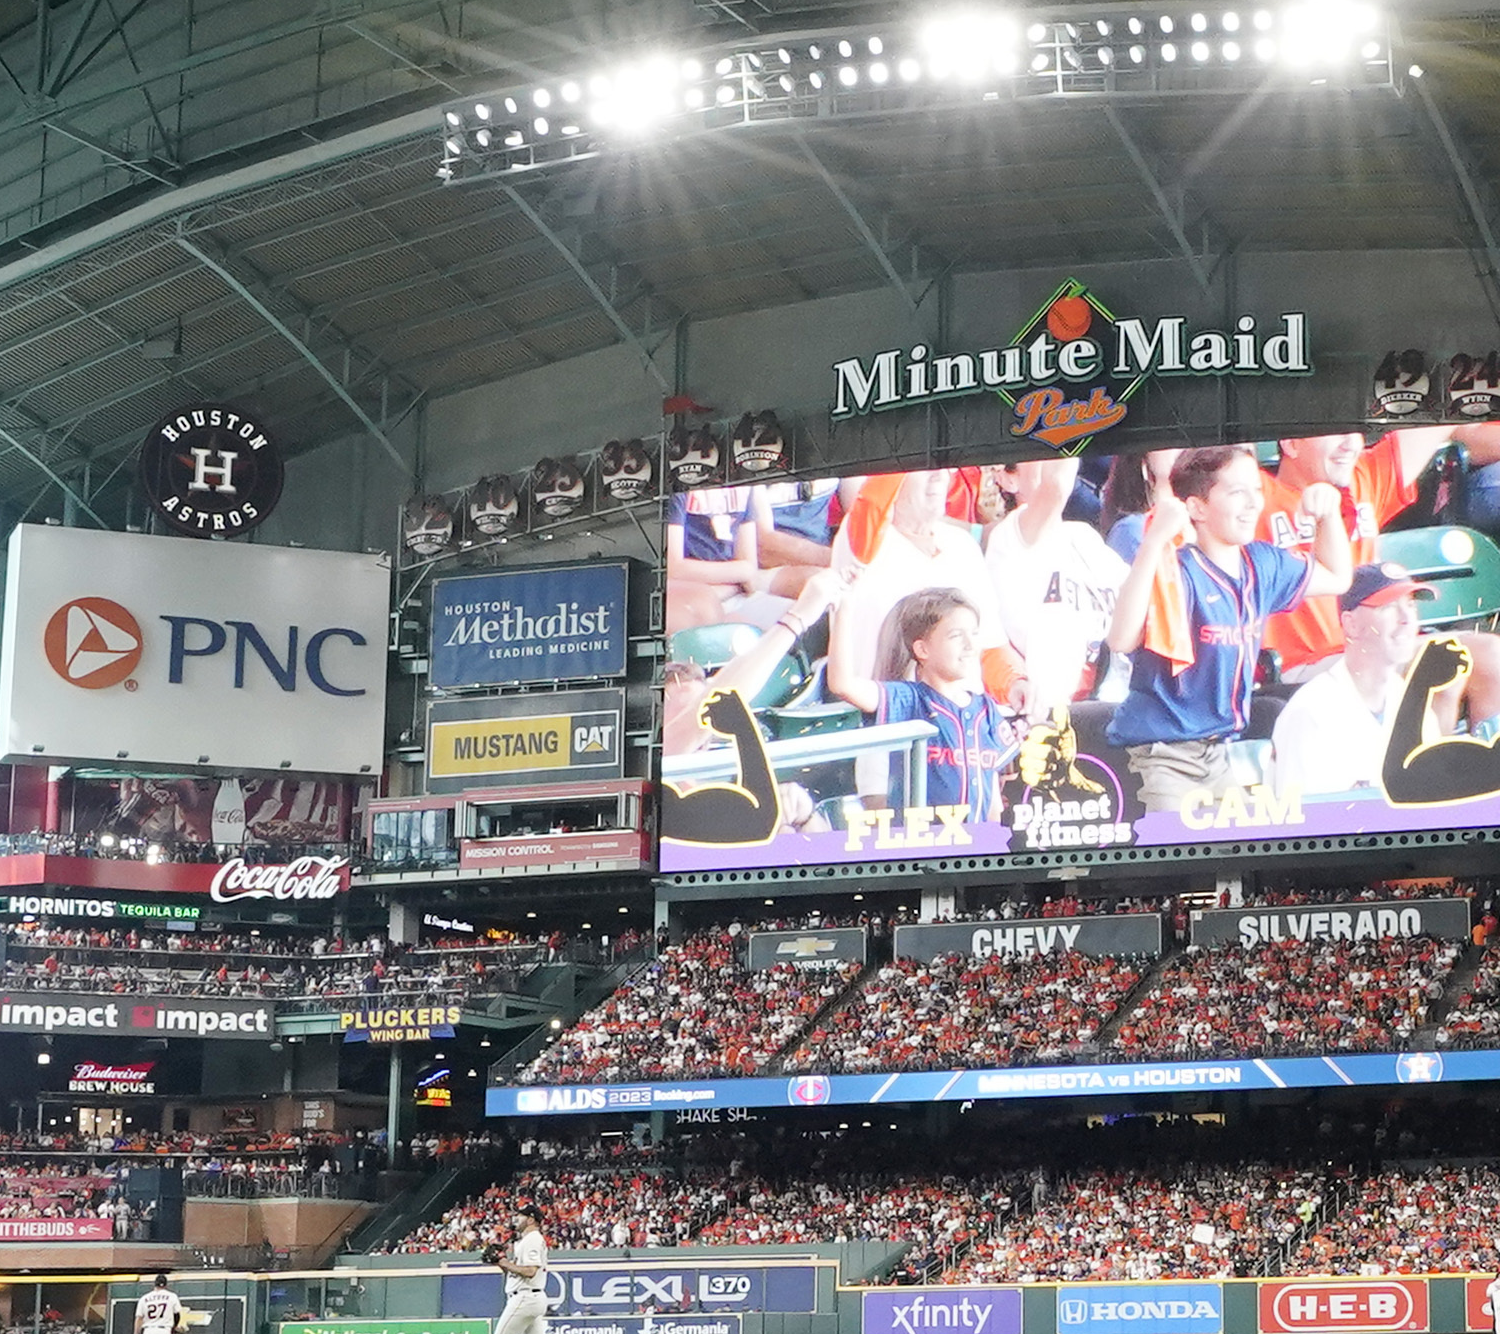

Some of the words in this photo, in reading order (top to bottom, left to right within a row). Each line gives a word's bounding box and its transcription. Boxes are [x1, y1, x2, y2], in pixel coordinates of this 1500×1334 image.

[832, 329, 1097, 420] Minute
[1114, 312, 1309, 374] Maid
[1462, 394, 1492, 405] WYNN
[1011, 386, 1128, 445] Park
[161, 410, 268, 451] HOUSTON
[188, 446, 238, 494] H
[735, 452, 779, 464] ROBINSON
[610, 479, 639, 490] SCOTT
[162, 495, 258, 530] ASTROS
[444, 600, 511, 617] HOUSTON
[443, 602, 611, 647] Methodist
[160, 614, 367, 696] PNC
[489, 644, 543, 660] LEADING
[550, 640, 610, 655] MEDICINE
[453, 730, 559, 761] MUSTANG
[574, 725, 612, 754] CAT
[843, 804, 973, 852] FLEX
[1179, 784, 1306, 831] CAM
[1012, 795, 1111, 833] planet
[1025, 817, 1134, 850] fitness
[465, 846, 507, 859] MISSION
[508, 843, 554, 857] CONTROL
[9, 895, 115, 918] HORNITOS
[120, 904, 172, 918] TEQUILA
[174, 906, 200, 919] BAR
[971, 924, 1082, 958] CHEVY
[1238, 908, 1422, 950] SILVERADO
[1, 1000, 119, 1031] impact
[156, 1003, 268, 1036] impact
[341, 1006, 461, 1030] PLUCKERS
[370, 1030, 405, 1043] WING
[408, 1029, 431, 1041] BAR
[75, 1063, 147, 1082] Budweiser
[978, 1073, 1104, 1093] MINNESOTA
[1134, 1067, 1241, 1086] HOUSTON
[68, 1080, 106, 1093] BREW
[110, 1081, 155, 1094] HOUSE
[547, 1088, 607, 1111] ALDS
[609, 1091, 652, 1104] 2023
[654, 1089, 715, 1103] Booking.com
[711, 1276, 751, 1294] 370
[147, 1303, 168, 1319] 27
[1090, 1300, 1220, 1321] HONDA
[1289, 1294, 1397, 1320] H-E-B
